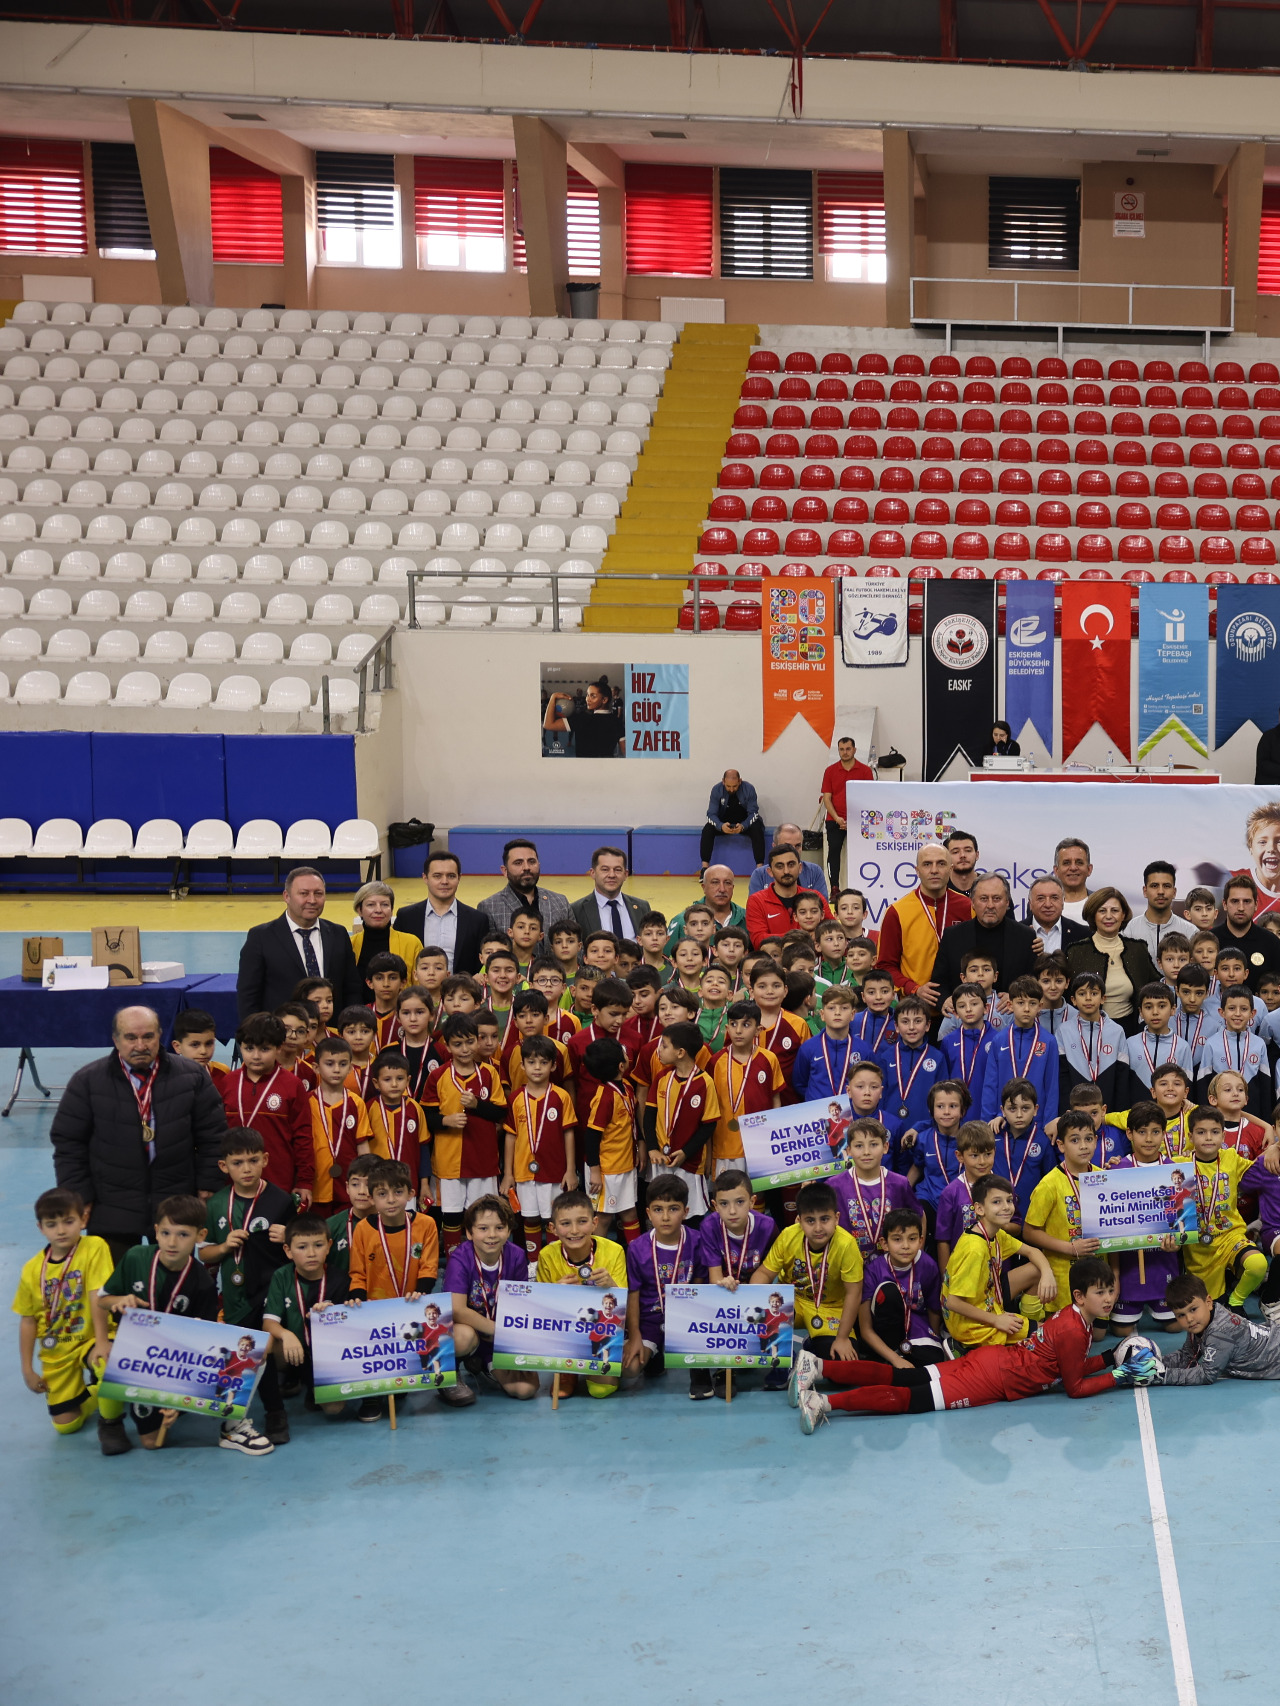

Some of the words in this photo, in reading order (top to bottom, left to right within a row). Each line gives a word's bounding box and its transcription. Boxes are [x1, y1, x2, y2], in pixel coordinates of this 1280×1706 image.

[1229, 616, 1252, 647] ODUNPAZARI
[1008, 651, 1042, 659] ESKİŞEHİR
[1157, 649, 1192, 657] TEPEBAŞI
[771, 661, 810, 672] ESKİŞEHİR
[811, 662, 826, 672] YILI
[1008, 658, 1050, 668] BÜYÜKŞEHİR
[1008, 667, 1045, 676] BELEDİYESİ
[631, 672, 656, 694] HIZ
[948, 679, 972, 691] EASKF
[632, 698, 662, 726] GÜÇ
[632, 730, 681, 752] ZAFER
[859, 861, 884, 888] 9.
[770, 1127, 791, 1141] ALT
[793, 1120, 826, 1136] YAPI
[784, 1150, 822, 1166] SPOR
[1098, 1192, 1108, 1202] 9.
[1110, 1186, 1176, 1201] Geleneksel
[1100, 1202, 1125, 1214] Mini
[1128, 1200, 1176, 1212] Minikler
[1099, 1214, 1135, 1227] Futsal
[1138, 1210, 1178, 1224] Şenliği
[715, 1304, 740, 1320] ASİ
[369, 1322, 396, 1340] ASİ
[504, 1314, 529, 1329] DSİ
[532, 1318, 572, 1332] BENT
[574, 1322, 616, 1336] SPOR
[688, 1322, 767, 1336] ASLANLAR
[340, 1340, 426, 1360] ASLANLAR
[706, 1337, 748, 1350] SPOR
[146, 1345, 225, 1370] ÇAMLICA
[362, 1358, 407, 1374] SPOR
[118, 1358, 194, 1382] GENÇLİK
[196, 1370, 244, 1392] SPOR
